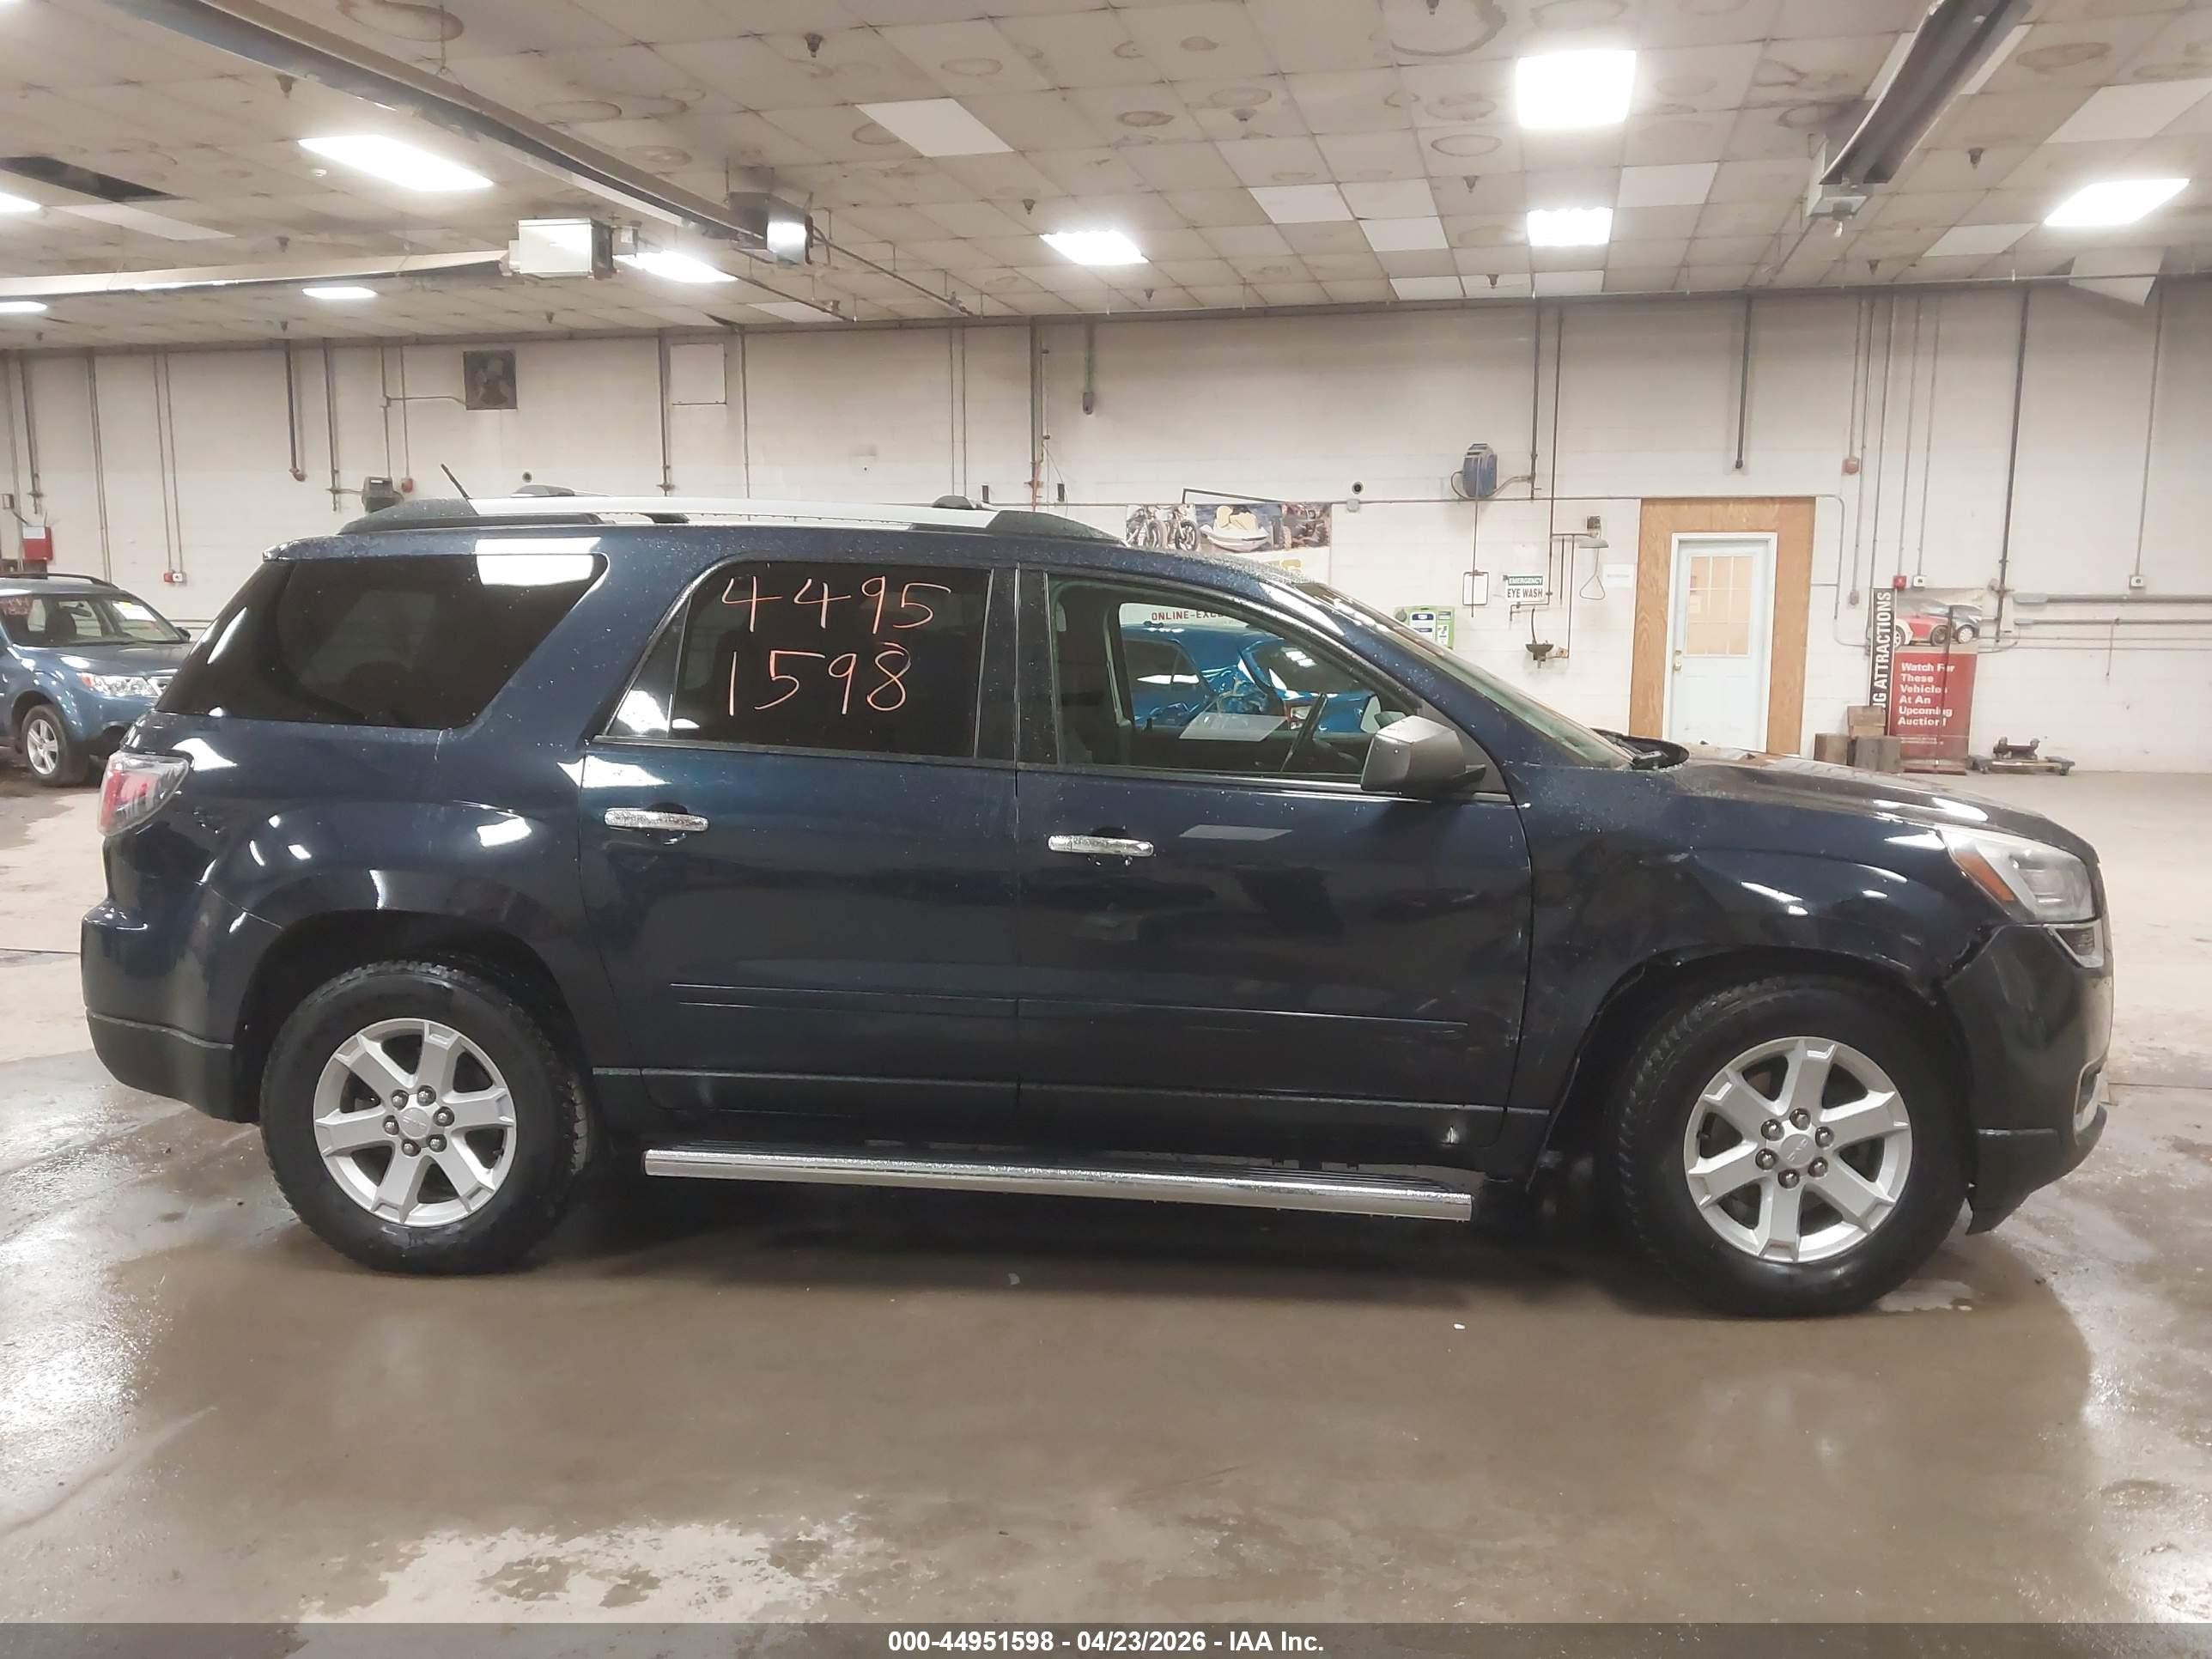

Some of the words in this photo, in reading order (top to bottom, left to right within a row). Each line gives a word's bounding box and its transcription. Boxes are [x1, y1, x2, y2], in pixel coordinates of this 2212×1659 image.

[1507, 588, 1520, 598] EYE
[1522, 588, 1543, 598] WASH
[721, 576, 951, 634] 4495
[1874, 592, 1892, 690] ATTRACTIONS
[1901, 662, 1934, 672] Watch
[729, 642, 911, 716] 1598
[1900, 673, 1934, 683] These
[1899, 696, 1911, 704] At
[1914, 696, 1931, 704] An
